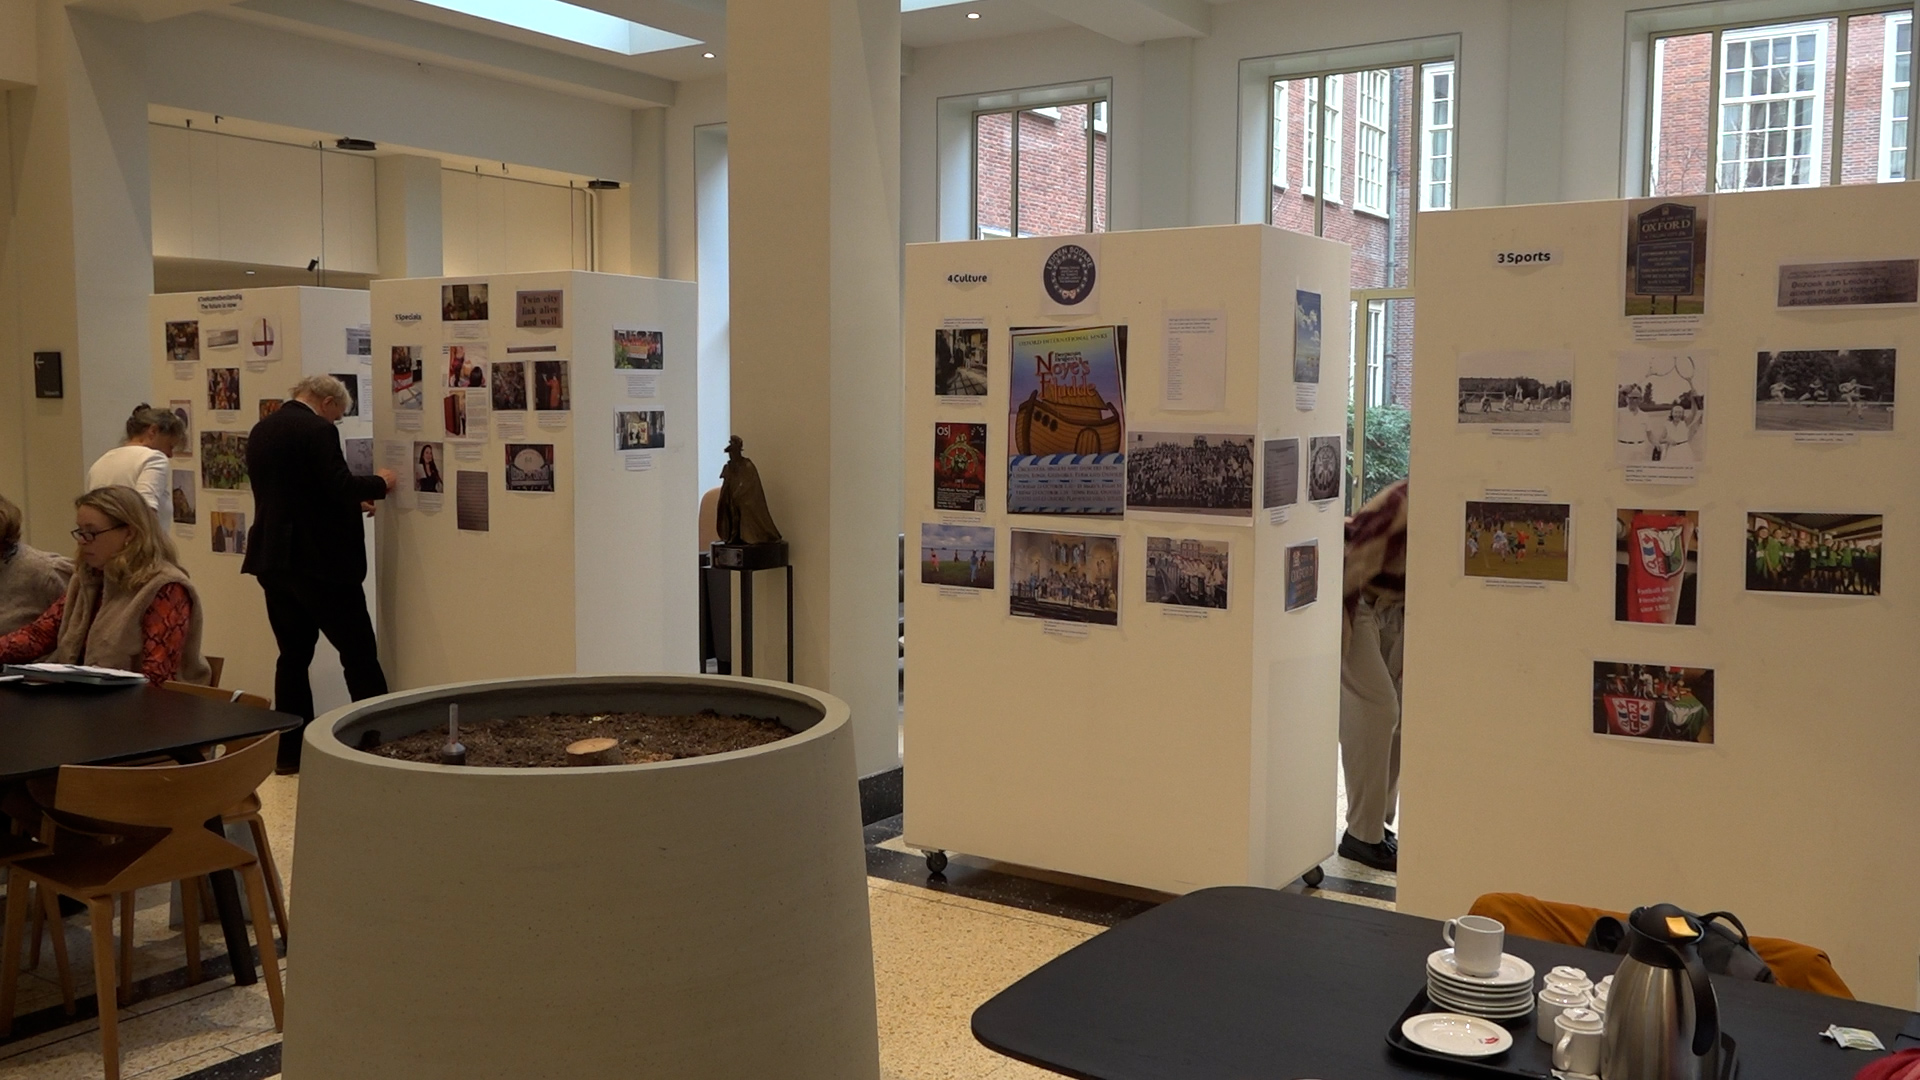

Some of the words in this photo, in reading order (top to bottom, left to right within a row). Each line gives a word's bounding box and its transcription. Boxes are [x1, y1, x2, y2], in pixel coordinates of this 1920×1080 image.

[1641, 219, 1691, 233] OXFORD
[1069, 246, 1094, 269] SQUARE
[522, 295, 540, 304] Twin
[543, 294, 557, 304] city
[521, 306, 536, 315] link
[540, 305, 559, 314] alive
[523, 317, 537, 326] and
[540, 316, 557, 325] well
[1043, 336, 1089, 345] INTERNATIONAL
[1035, 351, 1091, 380] Noye's
[1038, 373, 1097, 399] Fludde
